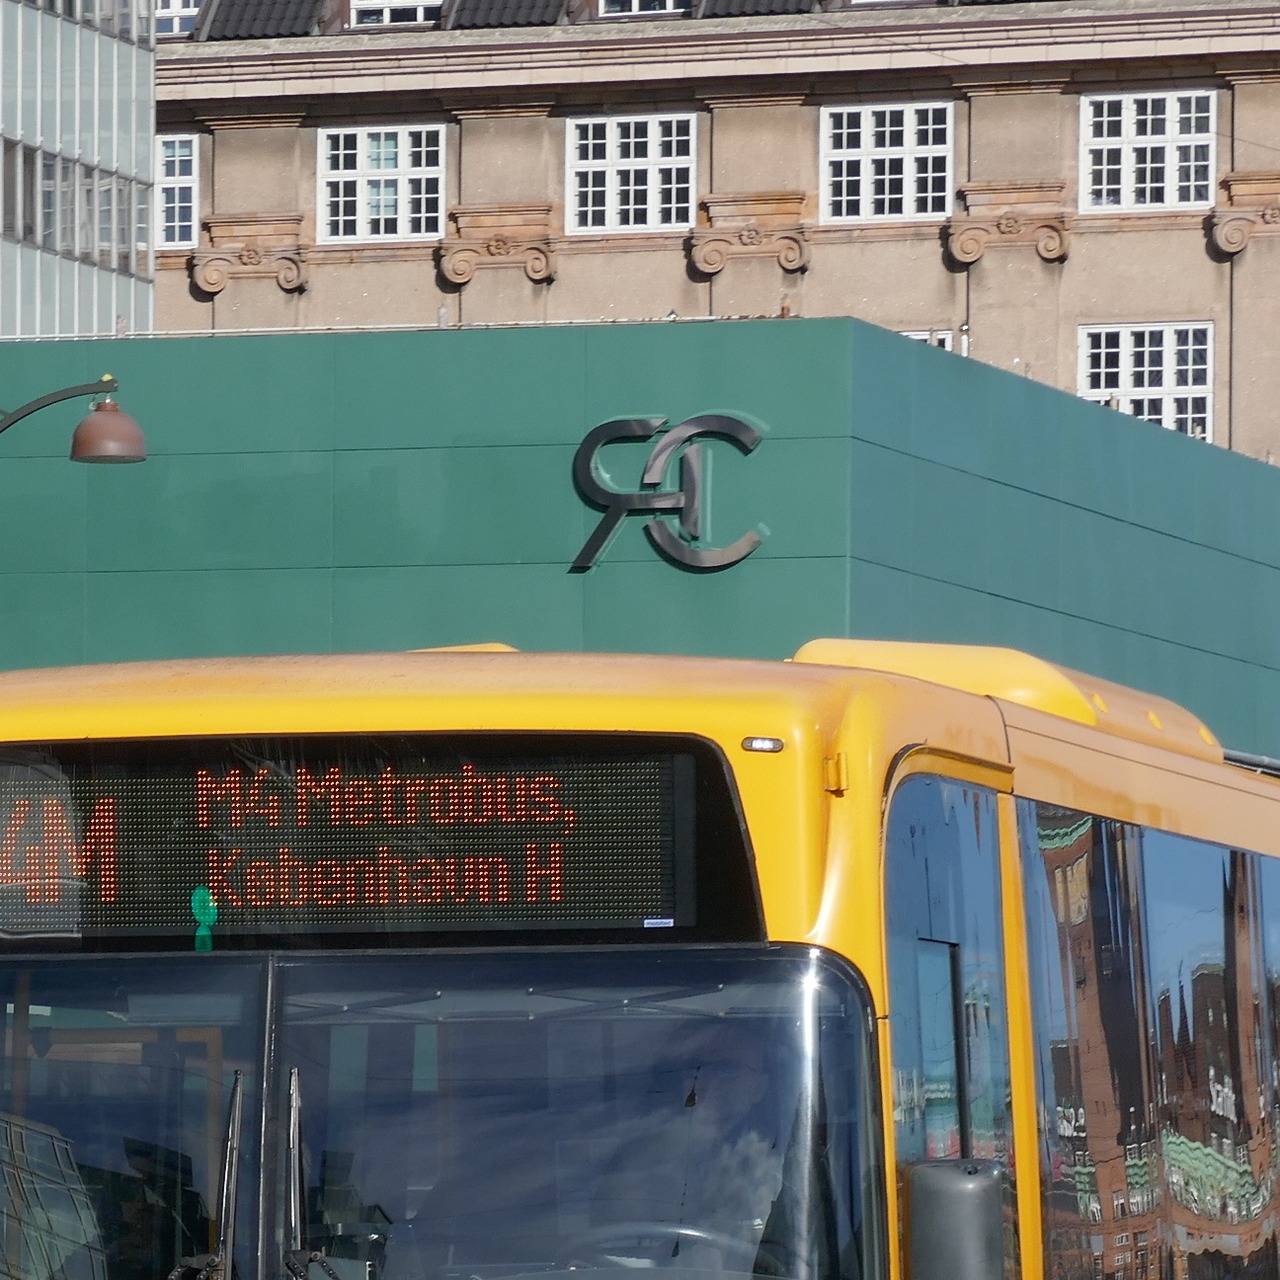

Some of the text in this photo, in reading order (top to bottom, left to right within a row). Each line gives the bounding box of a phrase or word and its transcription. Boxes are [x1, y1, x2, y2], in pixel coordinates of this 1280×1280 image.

[196, 764, 577, 836] M4 Metrobus,
[525, 843, 563, 903] H
